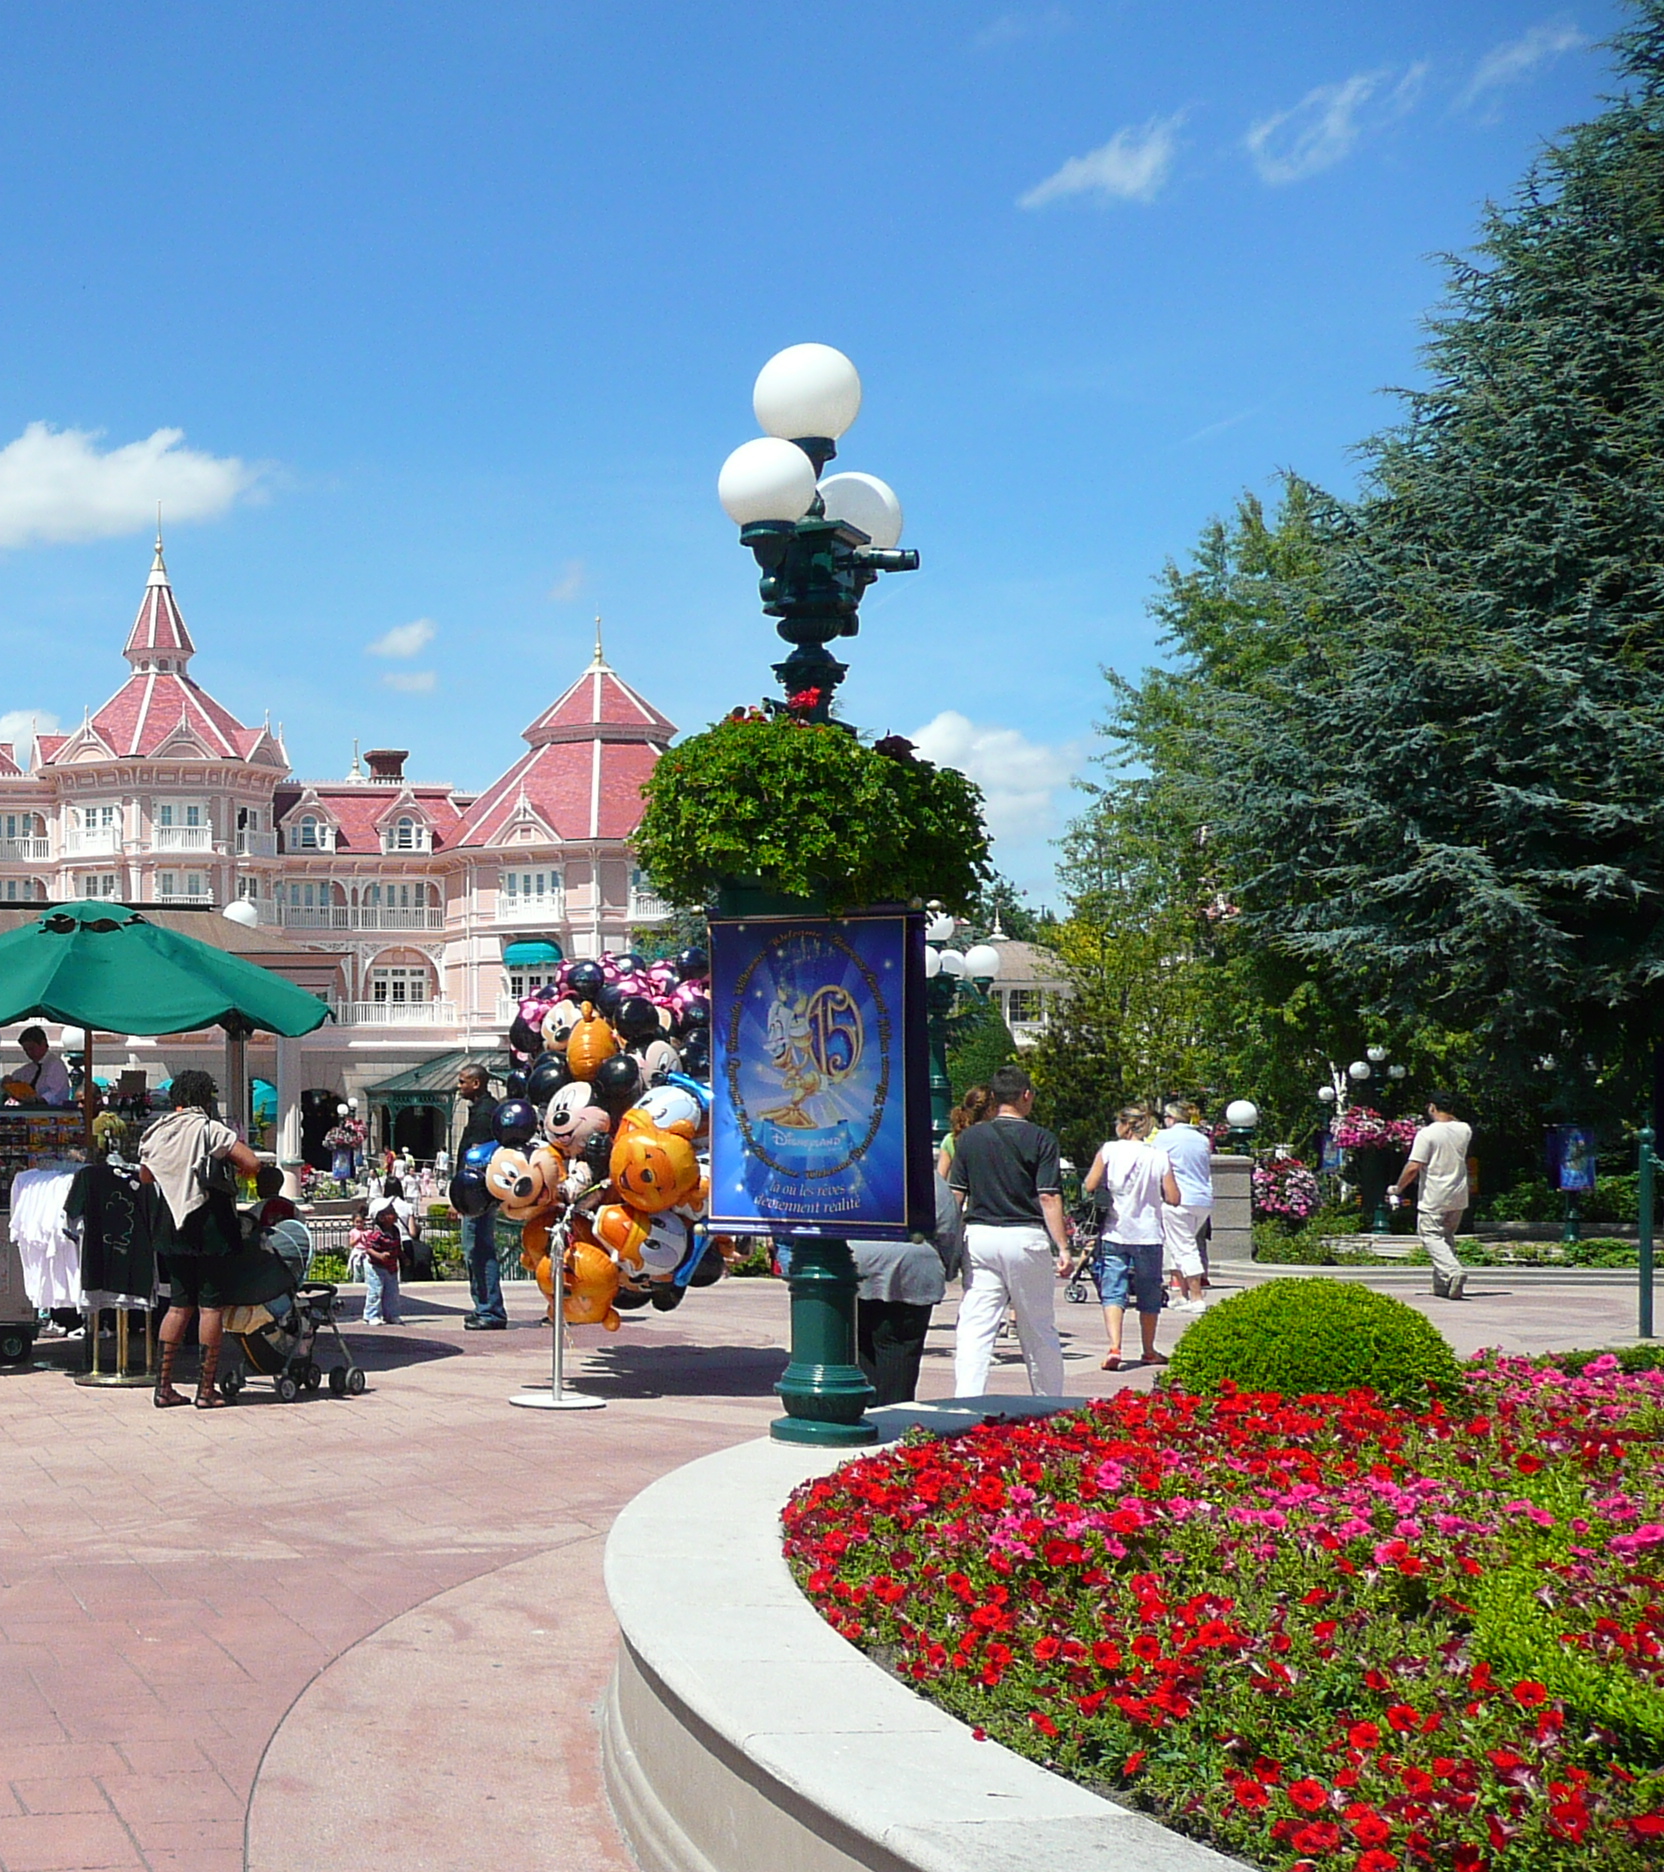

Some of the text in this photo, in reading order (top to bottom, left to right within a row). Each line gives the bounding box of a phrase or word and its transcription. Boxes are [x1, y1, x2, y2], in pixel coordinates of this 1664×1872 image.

[769, 929, 823, 947] Welcome
[808, 985, 864, 1078] 15
[799, 1184, 815, 1197] les
[753, 1194, 820, 1213] deviennent
